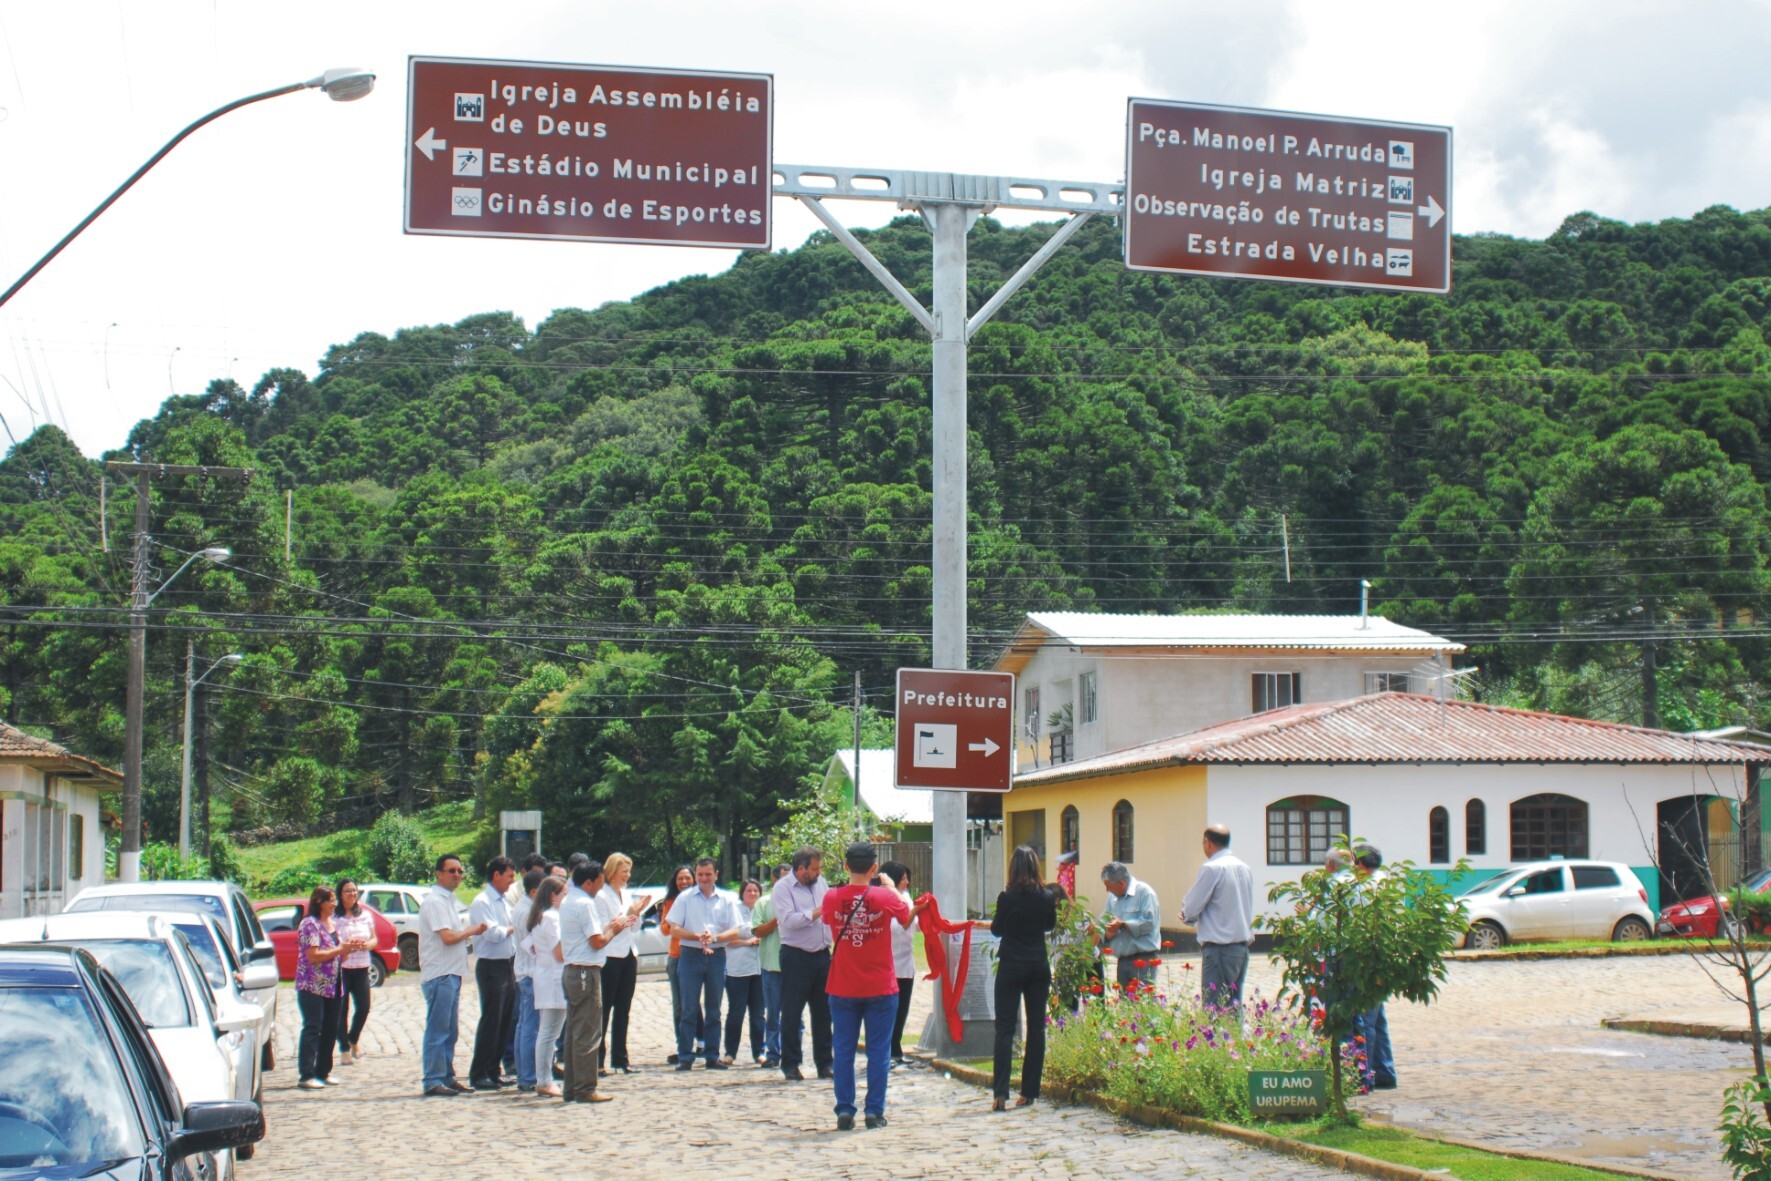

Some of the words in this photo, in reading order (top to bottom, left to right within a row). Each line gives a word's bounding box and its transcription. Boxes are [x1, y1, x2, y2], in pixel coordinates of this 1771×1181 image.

[491, 79, 577, 108] Igreja
[589, 84, 761, 112] Assembléia
[491, 114, 523, 134] de
[537, 115, 607, 138] Deus
[1139, 122, 1187, 148] Pça.
[1193, 127, 1275, 153] Manoel
[1283, 135, 1299, 155] P.
[1306, 137, 1385, 163] Arruda
[489, 153, 599, 177] Estádio
[613, 158, 758, 188] Municipal
[1202, 163, 1282, 194] Igreja
[1296, 172, 1385, 199] Matriz
[488, 192, 594, 218] Ginásio
[603, 198, 632, 220] de
[642, 200, 762, 226] Esportes
[1134, 193, 1264, 225] Observação
[1275, 205, 1300, 226] de
[1308, 208, 1385, 233] Trutas
[1187, 233, 1295, 261] Estrada
[1308, 243, 1384, 268] Velha
[904, 690, 1007, 709] Prefeitura
[1262, 1077, 1278, 1089] EU
[1281, 1077, 1313, 1089] AMO
[1256, 1095, 1318, 1107] URUPEMA
